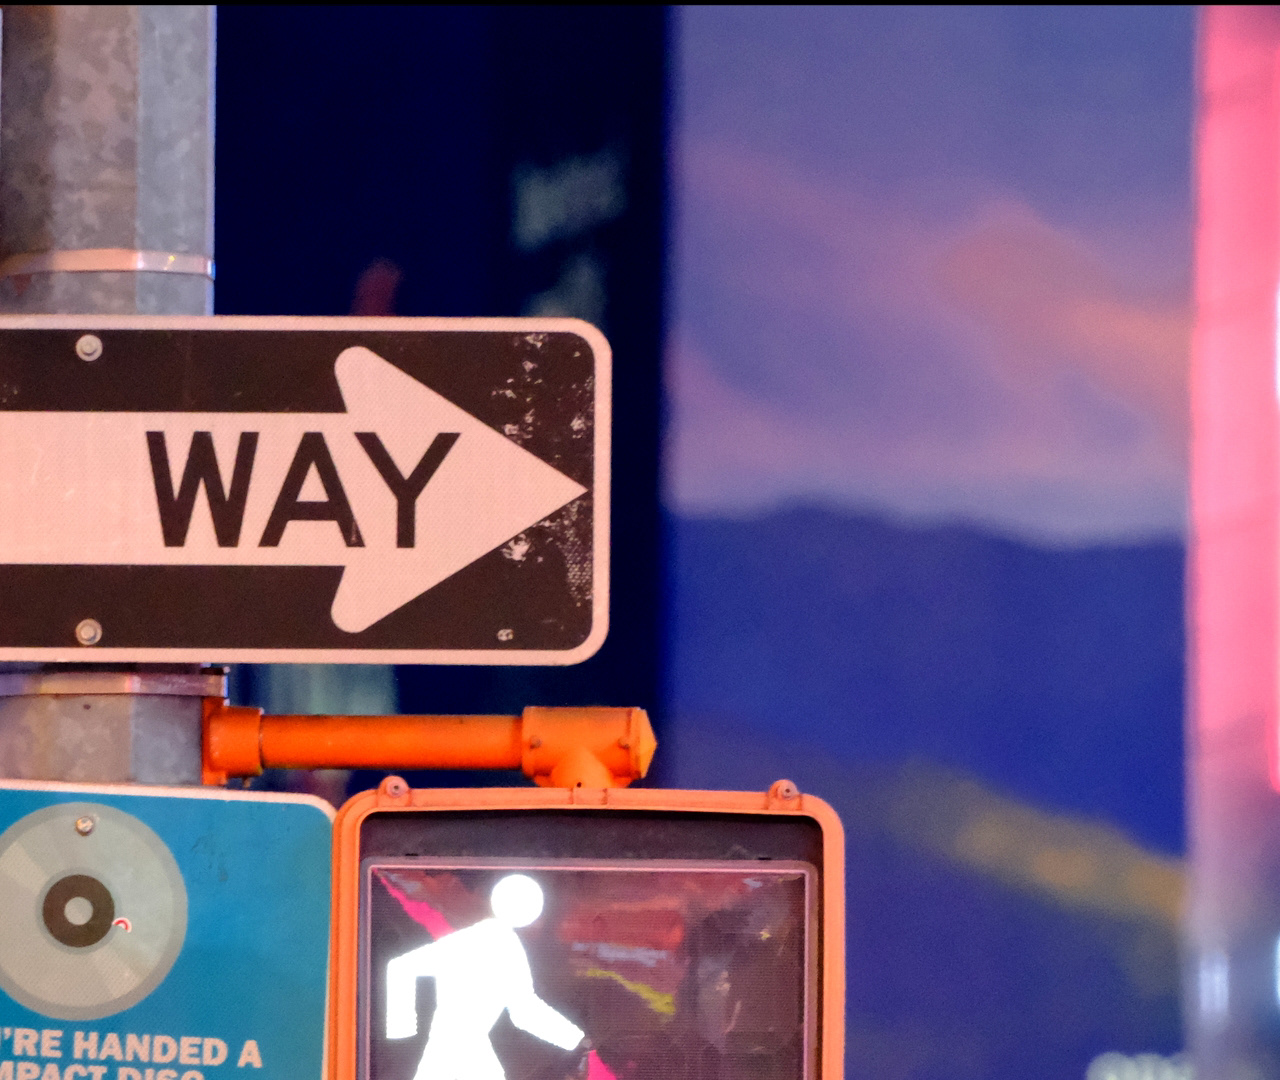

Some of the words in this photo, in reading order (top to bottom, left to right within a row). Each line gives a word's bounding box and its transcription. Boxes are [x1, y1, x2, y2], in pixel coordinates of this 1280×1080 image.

[146, 430, 461, 548] WAY
[73, 1031, 228, 1066] HANDED
[237, 1039, 263, 1068] A
